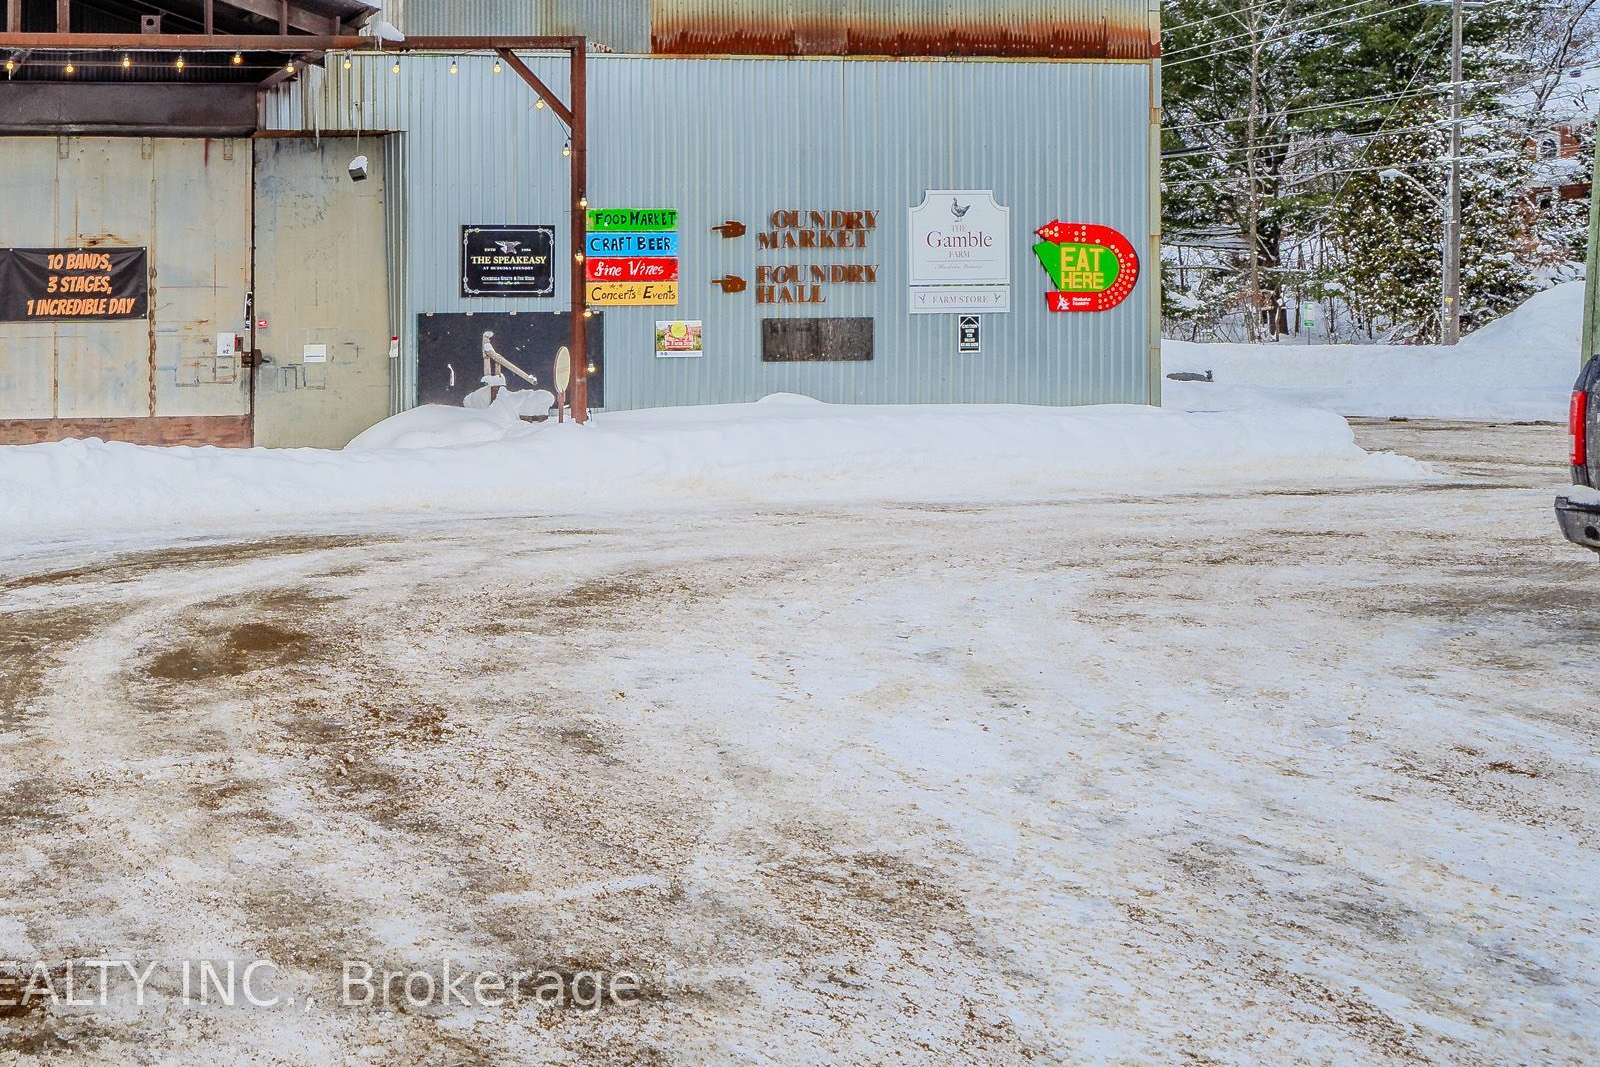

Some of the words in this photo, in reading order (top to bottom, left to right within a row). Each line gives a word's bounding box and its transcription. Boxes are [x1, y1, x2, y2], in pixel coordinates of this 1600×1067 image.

[595, 213, 627, 226] FOOD
[630, 211, 676, 226] MARKET
[590, 236, 632, 252] CRAFT
[637, 236, 671, 251] BEER
[758, 230, 870, 250] MARKET
[926, 230, 993, 248] Gamble
[47, 253, 64, 270] 10
[66, 253, 113, 272] BANDS,
[470, 256, 492, 265] THE
[493, 255, 547, 265] SPEAKEASY
[949, 250, 970, 258] FARM
[1061, 247, 1104, 272] EAT
[756, 263, 879, 284] FOUNDRY
[1061, 272, 1104, 289] HERE
[47, 275, 59, 293] 3
[60, 275, 113, 295] STAGES,
[592, 286, 636, 301] Concerts
[643, 284, 676, 300] Events
[756, 285, 827, 305] HALL
[932, 296, 957, 304] FARM
[959, 295, 989, 303] STORE
[27, 300, 35, 316] 1
[35, 298, 108, 316] INCREDIBLE
[109, 297, 136, 314] DAY
